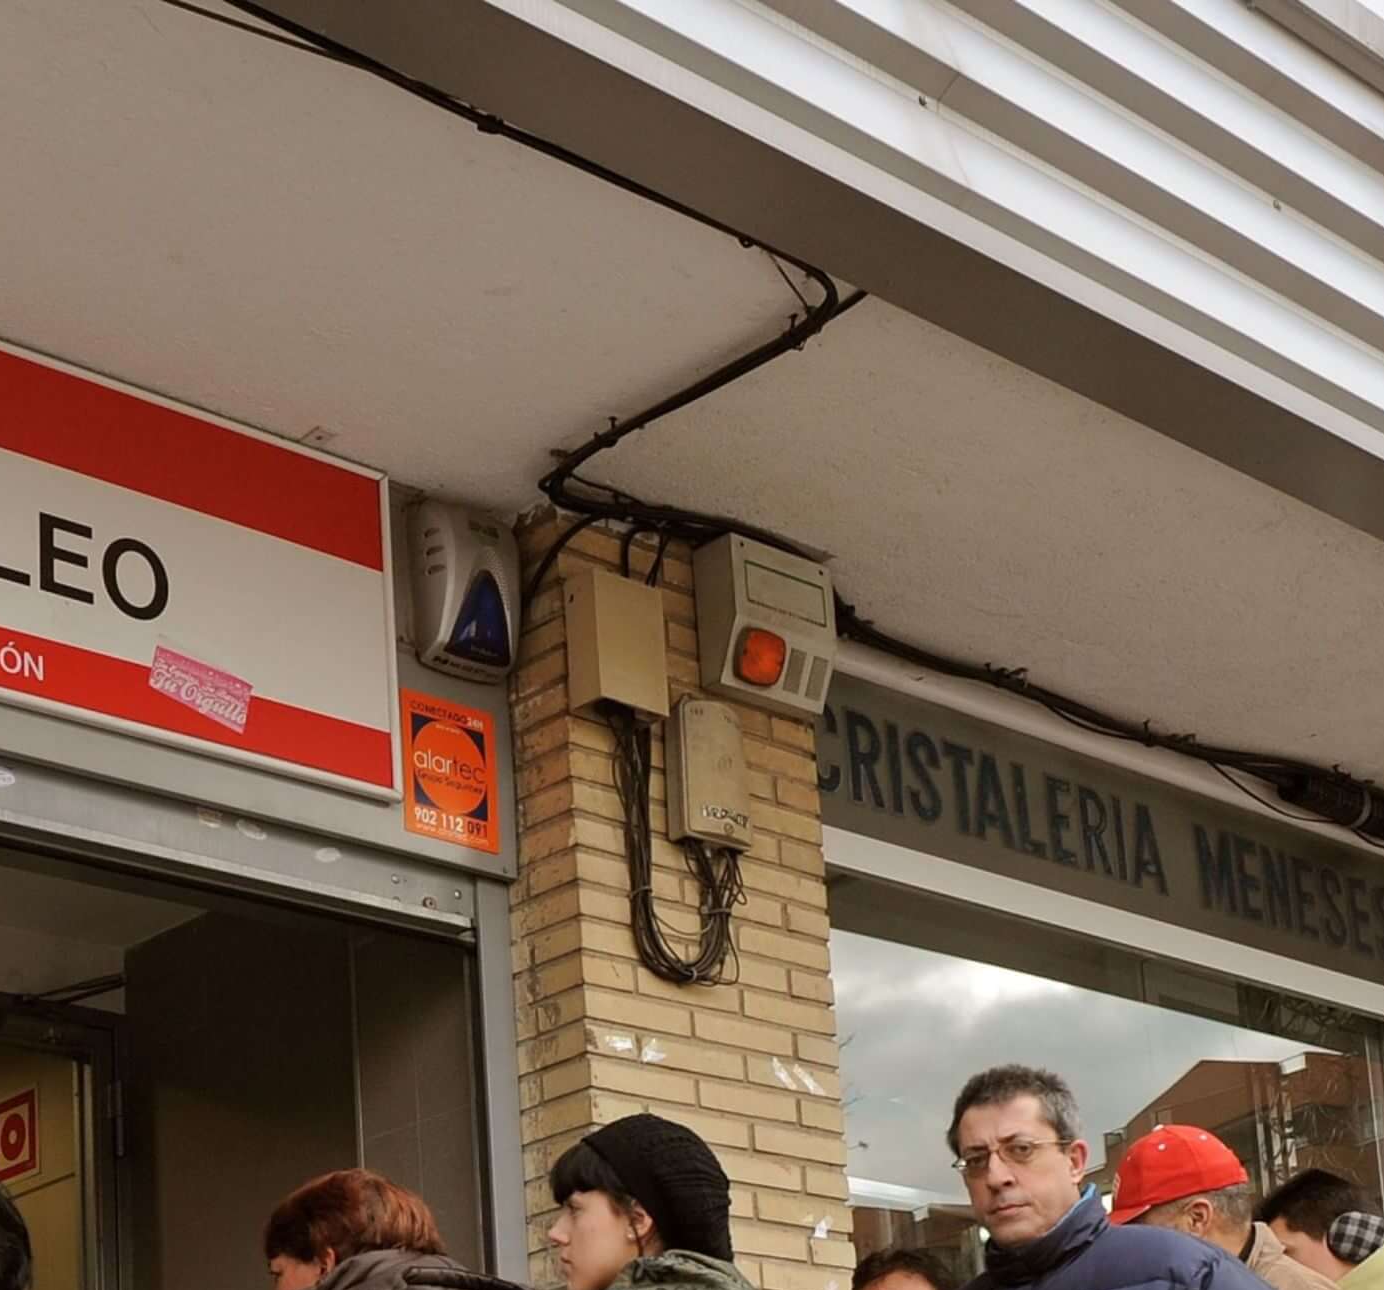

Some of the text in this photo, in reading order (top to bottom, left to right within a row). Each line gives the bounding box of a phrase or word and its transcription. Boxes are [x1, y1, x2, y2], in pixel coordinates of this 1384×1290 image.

[414, 748, 487, 785] alartec
[816, 703, 1169, 896] CRISTALERIA
[414, 806, 438, 826] 902
[441, 813, 464, 834] 112
[467, 820, 488, 839] 091
